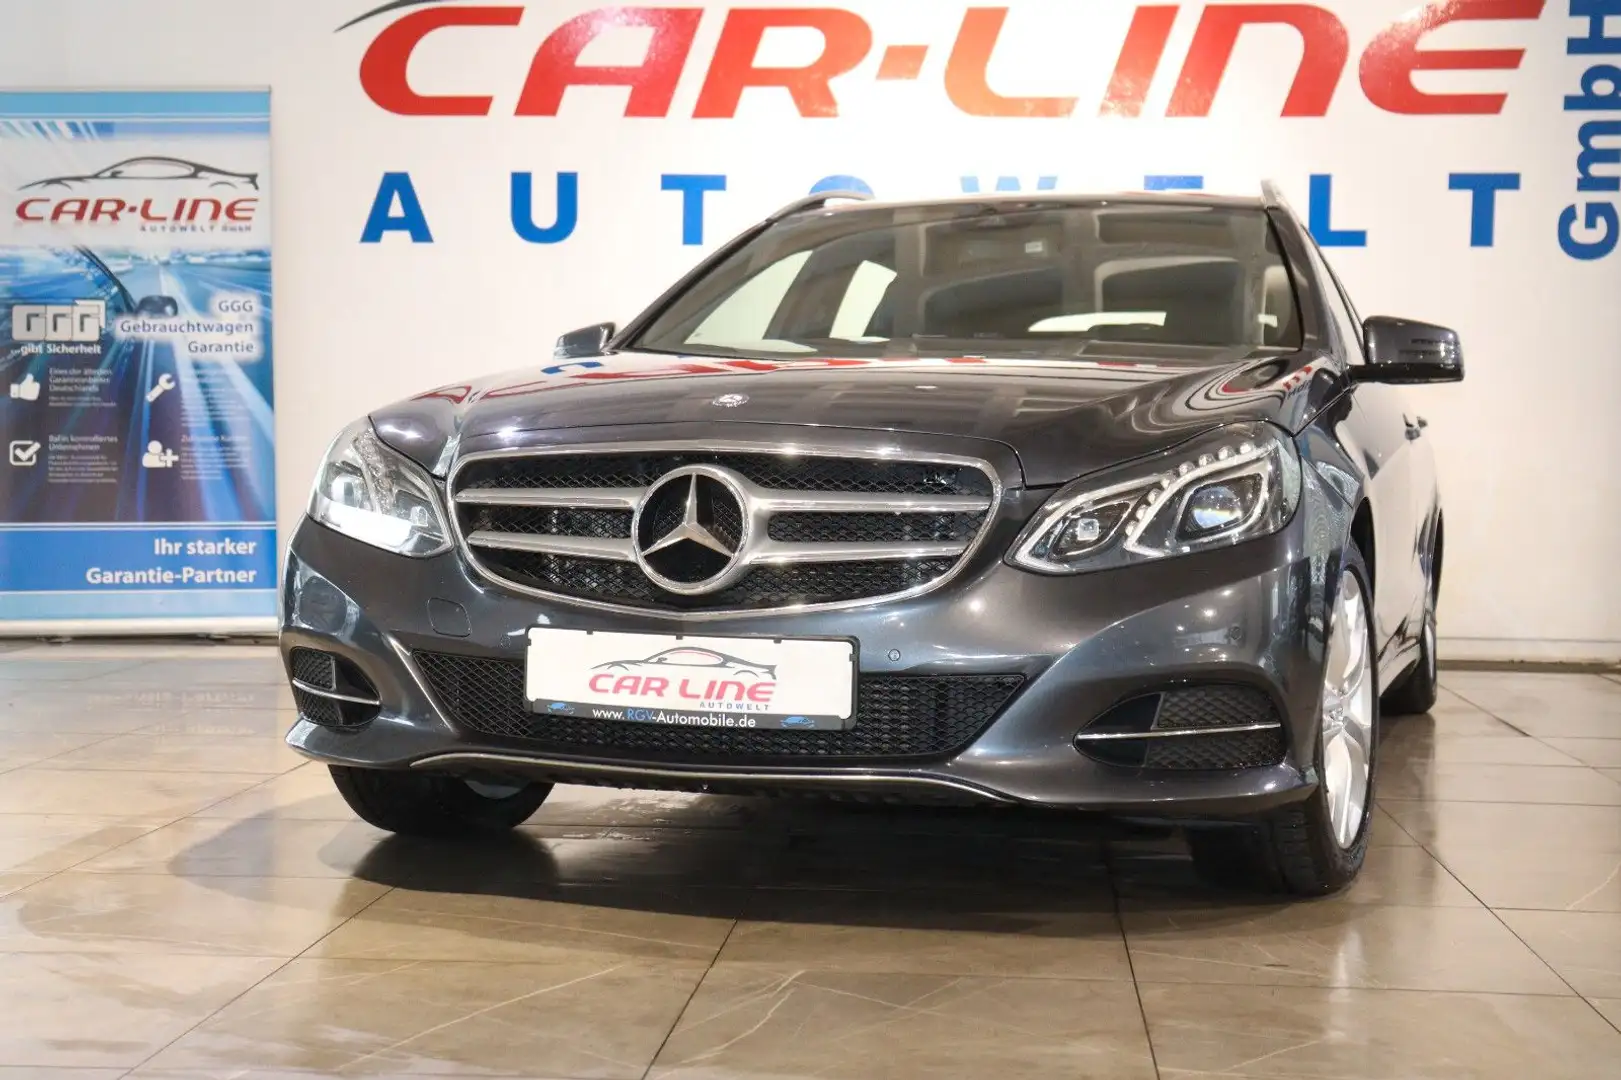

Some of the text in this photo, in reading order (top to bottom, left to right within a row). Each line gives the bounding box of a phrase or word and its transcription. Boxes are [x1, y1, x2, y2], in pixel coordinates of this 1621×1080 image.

[359, 0, 1547, 119] CAR-LINE
[1557, 0, 1621, 261] GmbH
[16, 197, 259, 221] CAR-LINE
[218, 300, 254, 312] GGG
[119, 319, 254, 335] Gebrauchtwagen
[46, 343, 102, 354] Sicherheit
[187, 341, 254, 353] Garantie
[154, 538, 257, 555] Ihr starker
[86, 567, 257, 585] Garantie-Partner
[588, 673, 777, 703] CAR LINE
[699, 701, 771, 712] AUTOWELT
